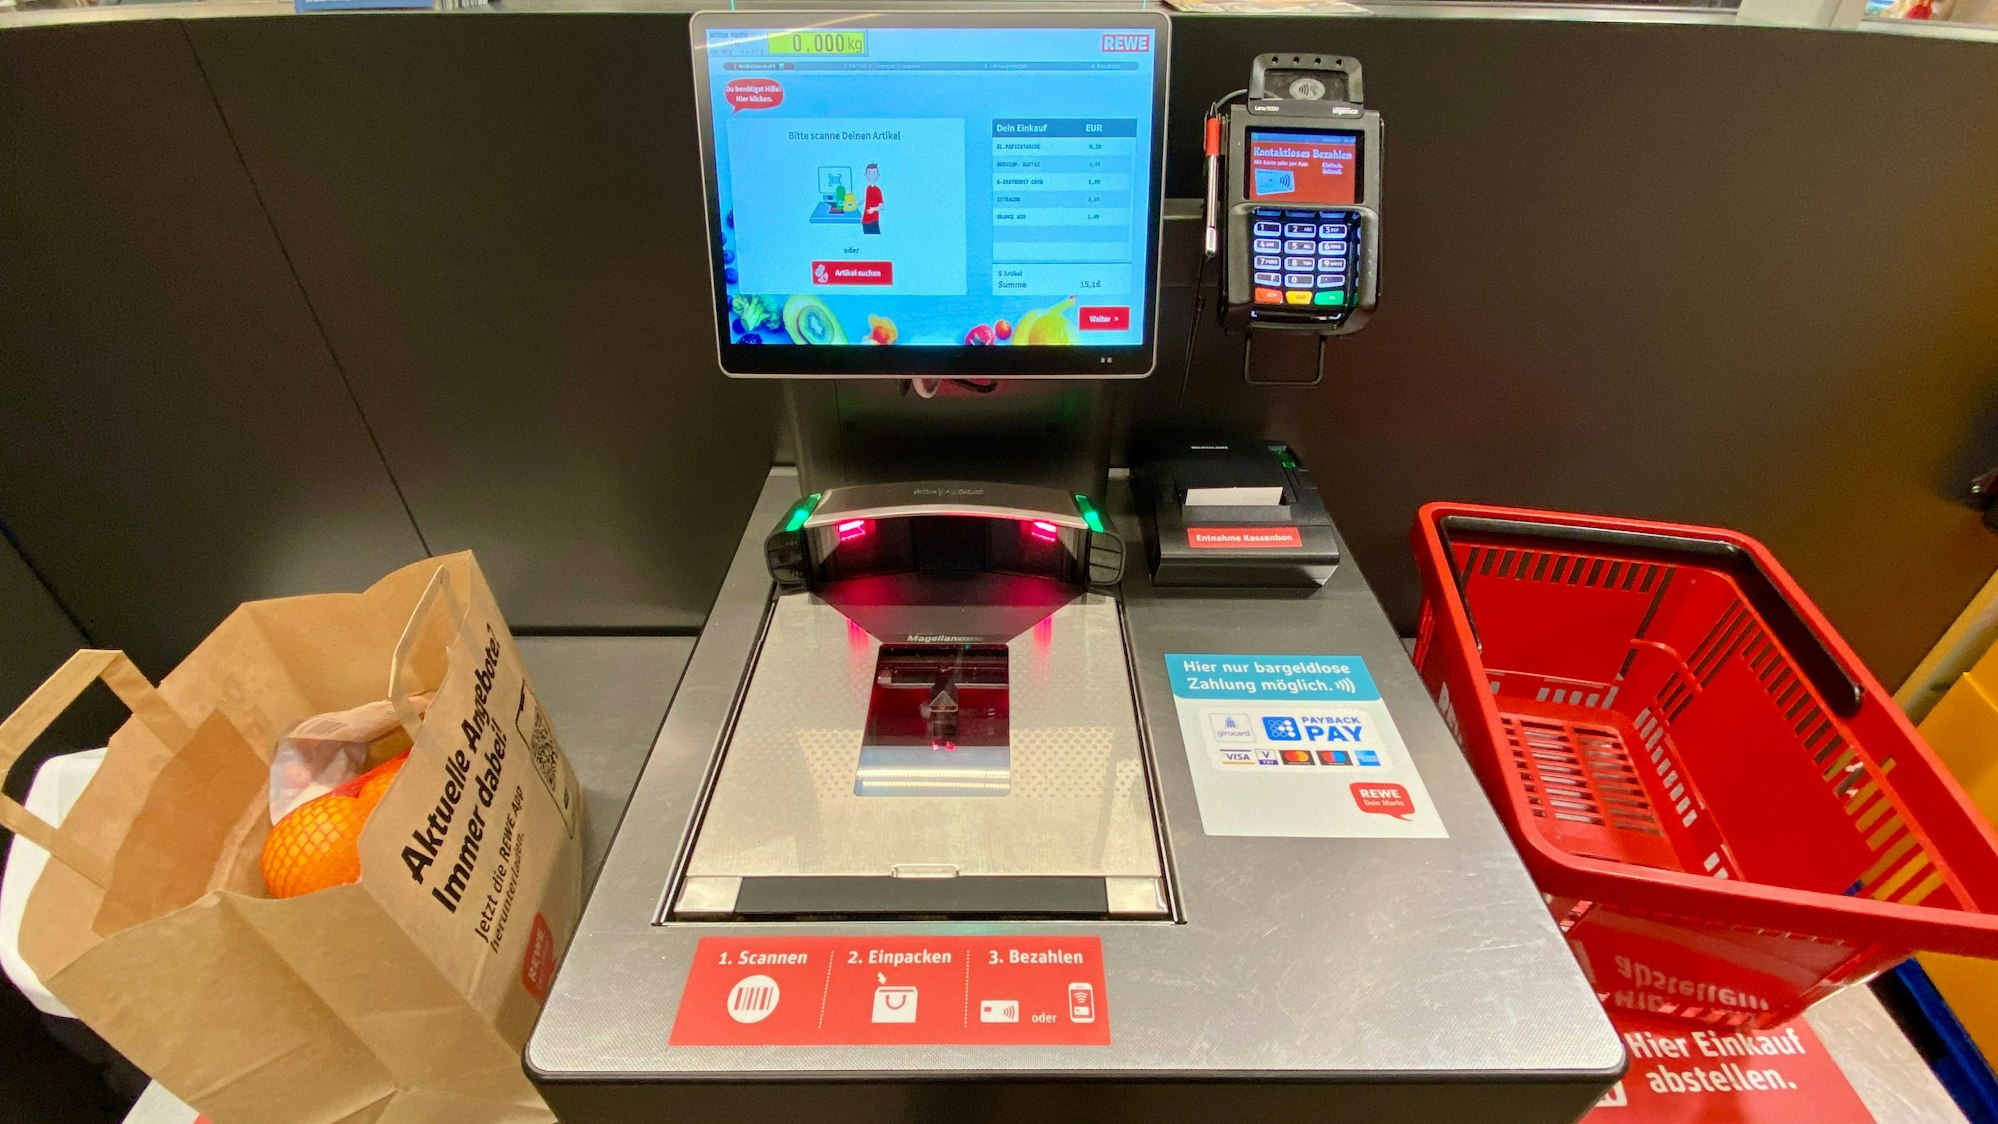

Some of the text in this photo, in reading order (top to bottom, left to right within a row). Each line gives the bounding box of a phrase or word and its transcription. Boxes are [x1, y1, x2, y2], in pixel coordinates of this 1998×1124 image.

[793, 34, 862, 52] 0.000 kg
[1103, 36, 1148, 50] REWE
[726, 85, 783, 94] Du benötigst Hilfe?
[735, 95, 773, 103] Hier klicken.
[1332, 107, 1359, 115] ingenico
[997, 124, 1047, 132] Dein Einkauf
[1085, 124, 1103, 132] EUR
[789, 131, 900, 140] Bitte scanne Deinen Artikel
[1253, 147, 1352, 160] Kontaktloses Bezahlen
[835, 269, 857, 277] Artikel
[1079, 280, 1101, 289] 15,16
[1089, 315, 1111, 323] Weiter
[1196, 534, 1293, 542] Entnahme Kassenbon
[907, 634, 957, 644] Magellan
[1183, 661, 1351, 677] Hier nur bargeldlose
[1187, 677, 1333, 694] Zahlung möglich.
[1301, 716, 1361, 725] PAYBACK
[1217, 729, 1250, 738] girocard
[1305, 725, 1363, 742] PAY
[400, 622, 503, 886] Aktuelle Angebote?
[1226, 753, 1250, 761] VISA
[1262, 751, 1271, 759] V
[1359, 788, 1401, 799] REWE
[1364, 799, 1381, 807] Dein
[431, 721, 508, 915] Immer dabei!
[474, 785, 525, 944] Jetzt die REWE App
[490, 832, 525, 955] herunterladen.
[528, 927, 545, 983] REWE
[718, 951, 808, 966] 1. Scannen
[848, 949, 952, 967] 2. Einpacken
[989, 950, 1083, 965] 3. Bezahlen
[1031, 1011, 1057, 1024] oder
[1625, 1028, 1807, 1058] Hier Einkauf
[1646, 1063, 1797, 1094] abstellen.
